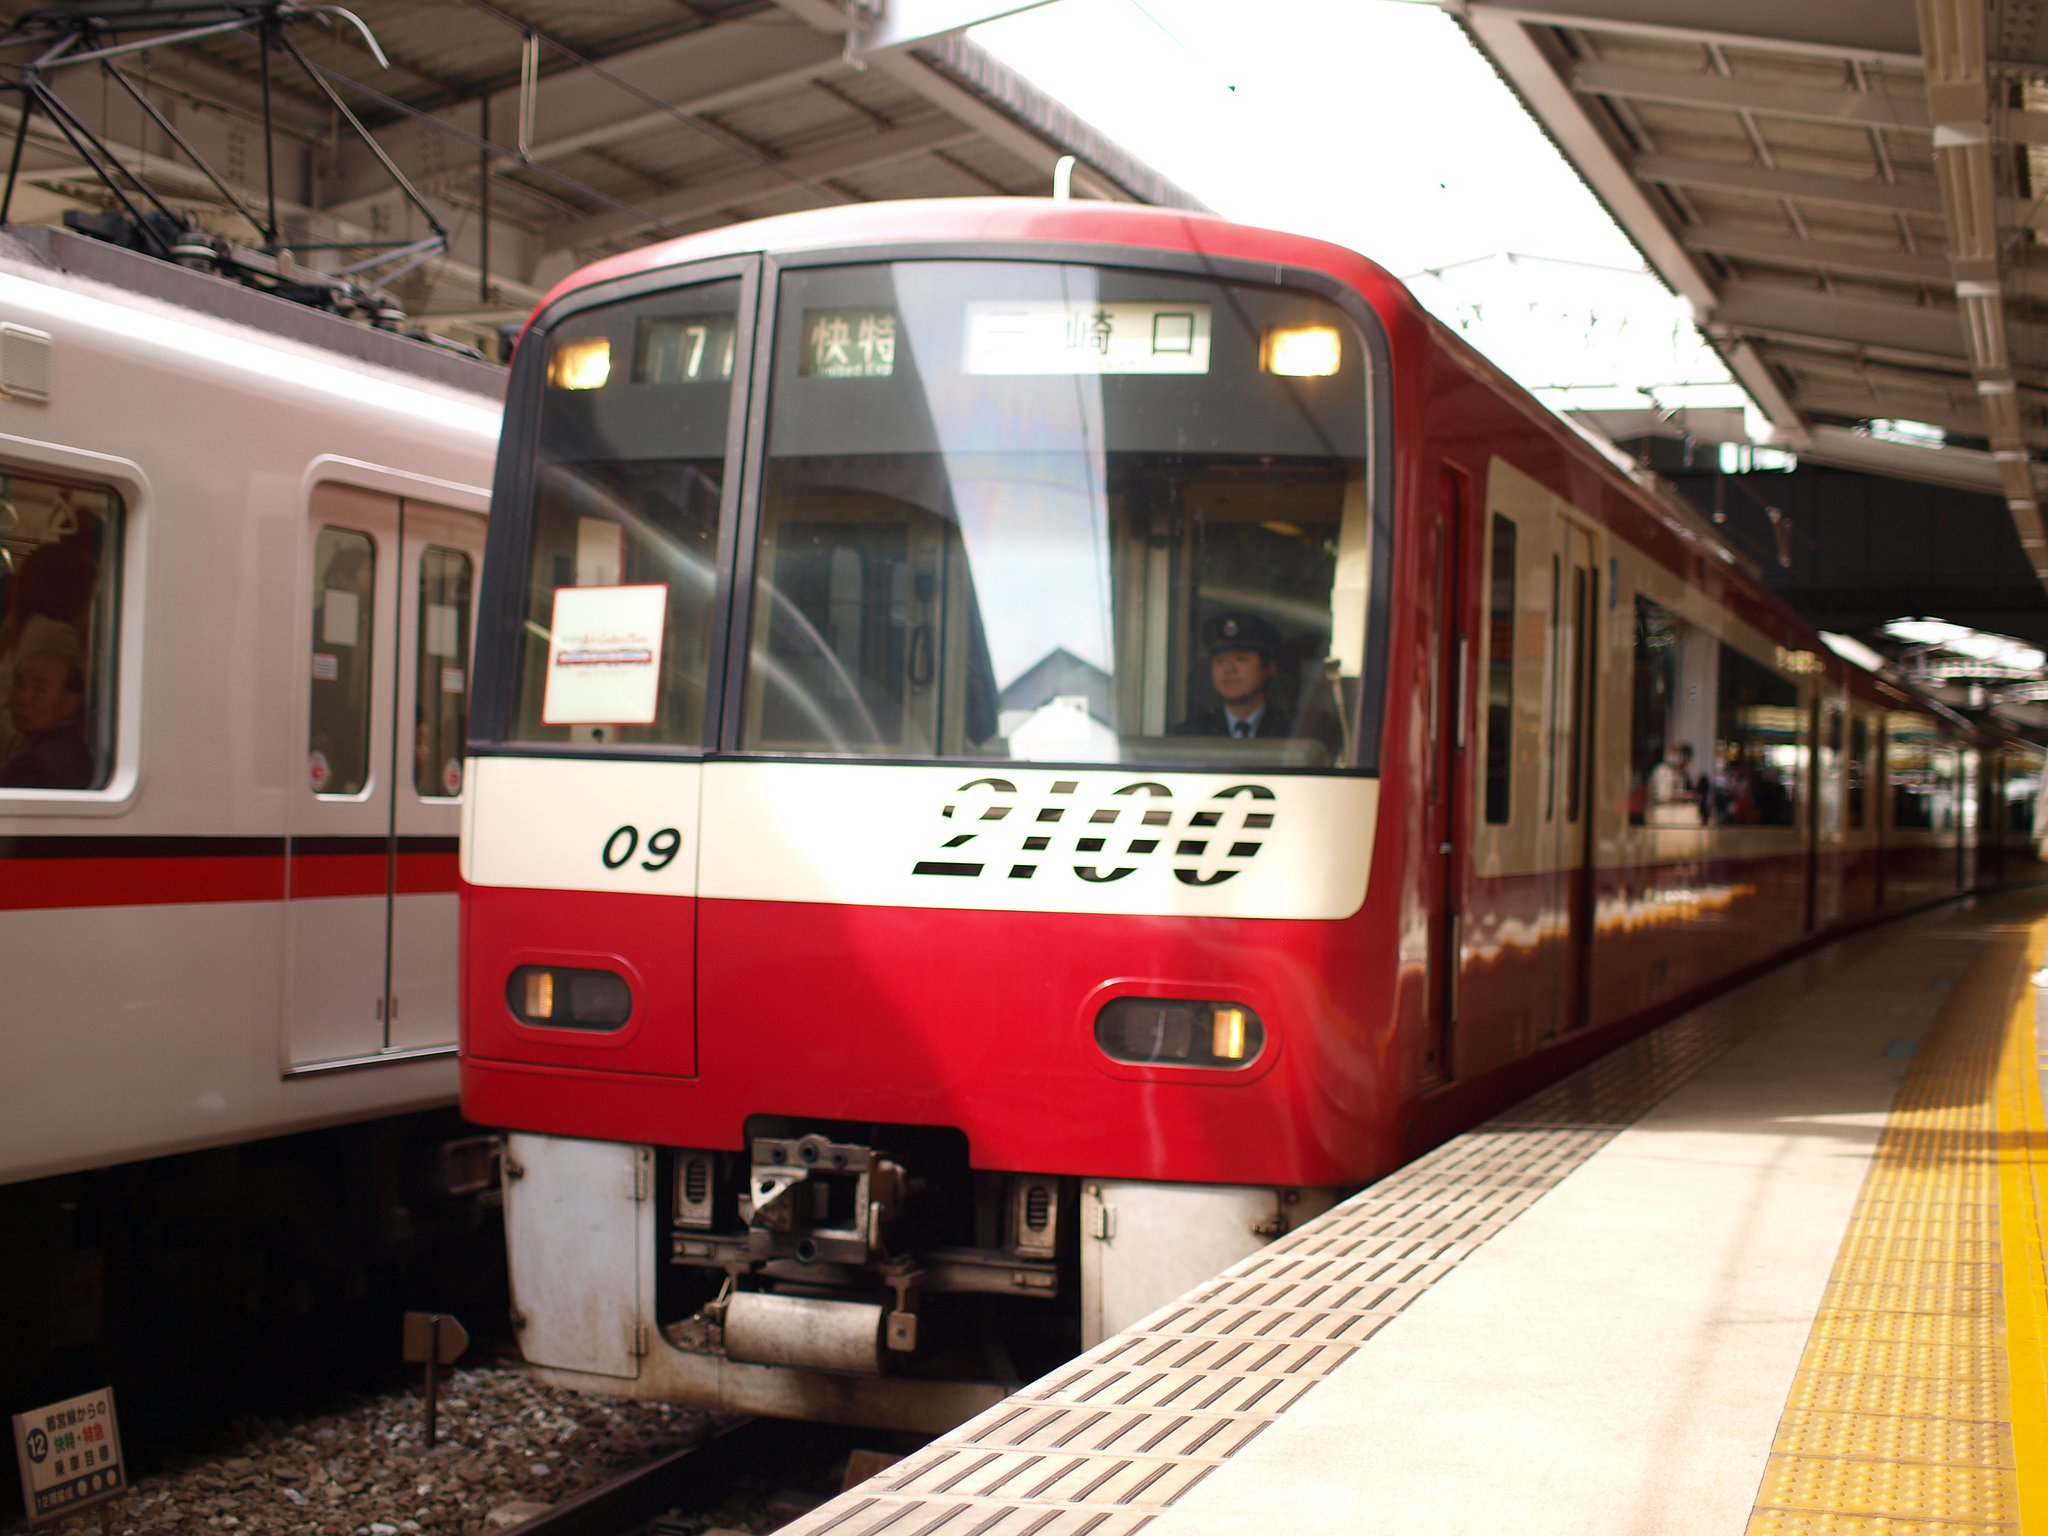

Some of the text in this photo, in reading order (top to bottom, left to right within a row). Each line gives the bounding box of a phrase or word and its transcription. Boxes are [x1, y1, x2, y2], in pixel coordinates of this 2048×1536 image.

[811, 314, 896, 366] 快特
[983, 311, 1193, 356] 三崎口
[600, 824, 682, 872] 09
[912, 777, 1276, 886] 2100
[28, 1434, 46, 1457] 12
